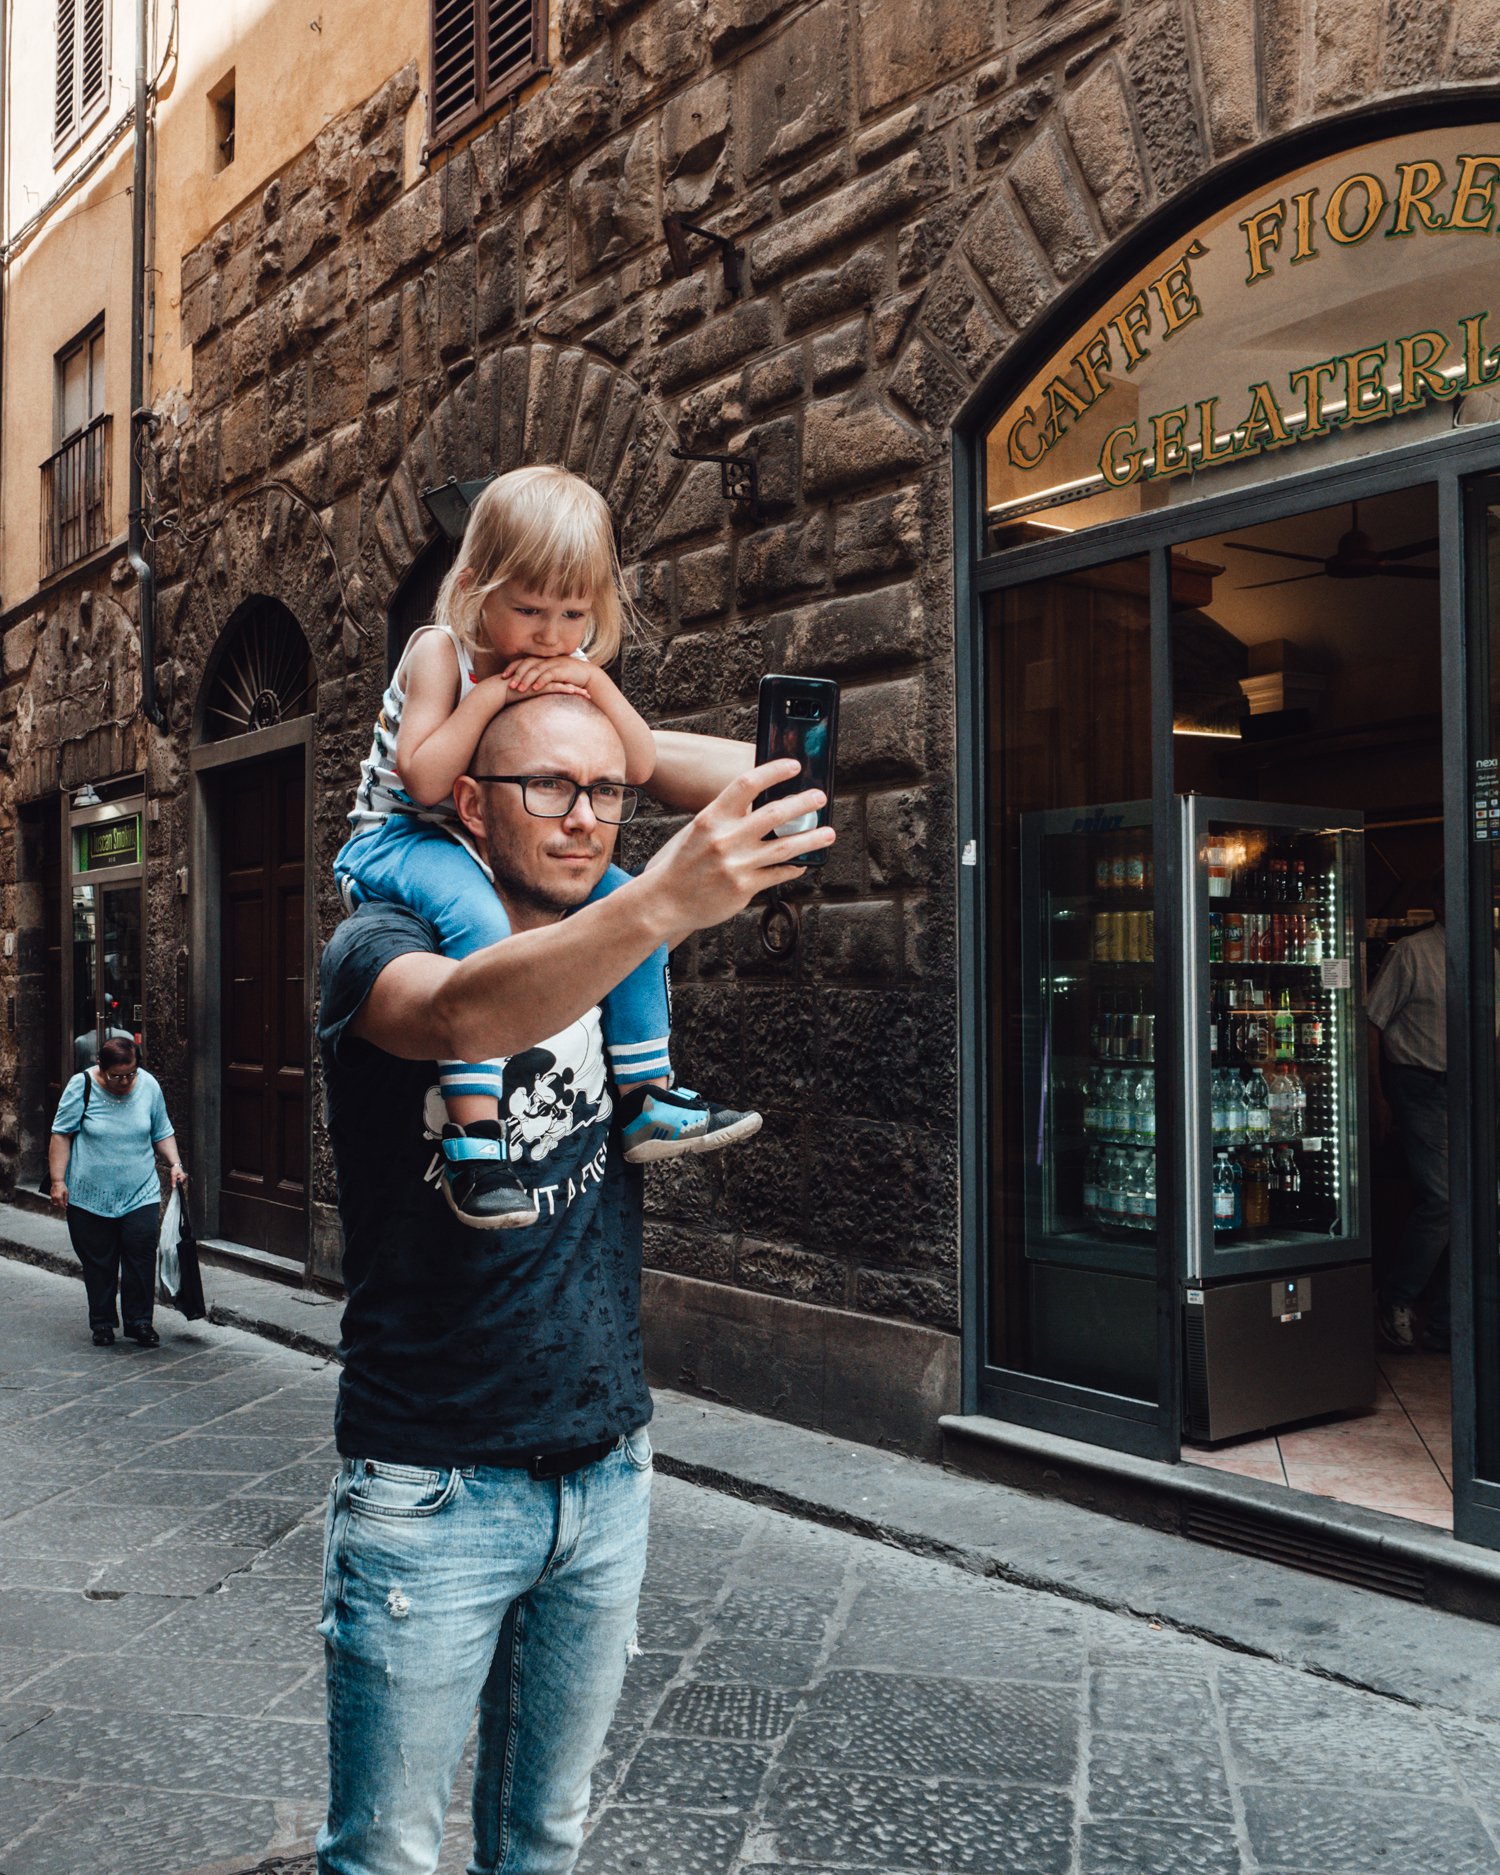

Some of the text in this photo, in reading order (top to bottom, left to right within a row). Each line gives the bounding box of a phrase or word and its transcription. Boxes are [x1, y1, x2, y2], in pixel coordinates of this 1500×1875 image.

[1239, 153, 1500, 286] FIORE
[1098, 311, 1500, 489] GELATERI
[1476, 759, 1497, 767] nexi
[580, 1131, 609, 1194] FIG
